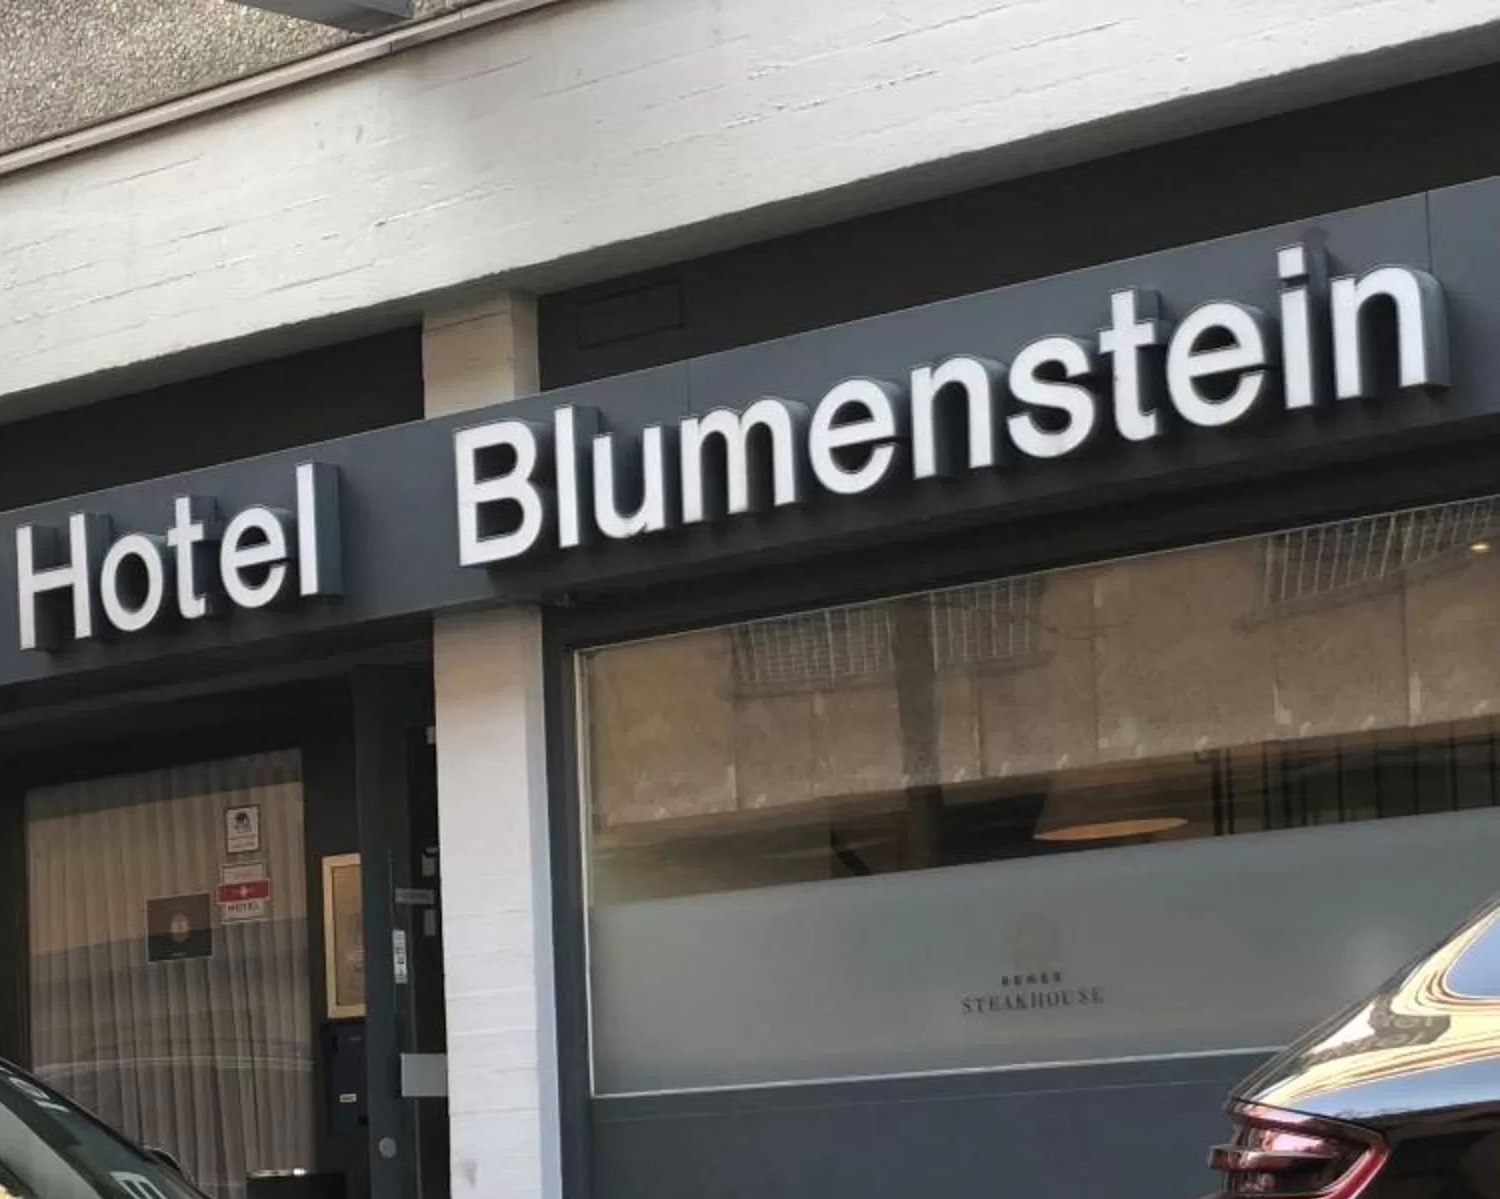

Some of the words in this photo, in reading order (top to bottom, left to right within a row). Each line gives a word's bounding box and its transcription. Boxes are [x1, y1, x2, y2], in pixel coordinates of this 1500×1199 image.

[15, 462, 318, 650] Hotel
[456, 247, 1427, 567] Blumenstein
[961, 987, 1106, 1014] STEAKHOUSE
